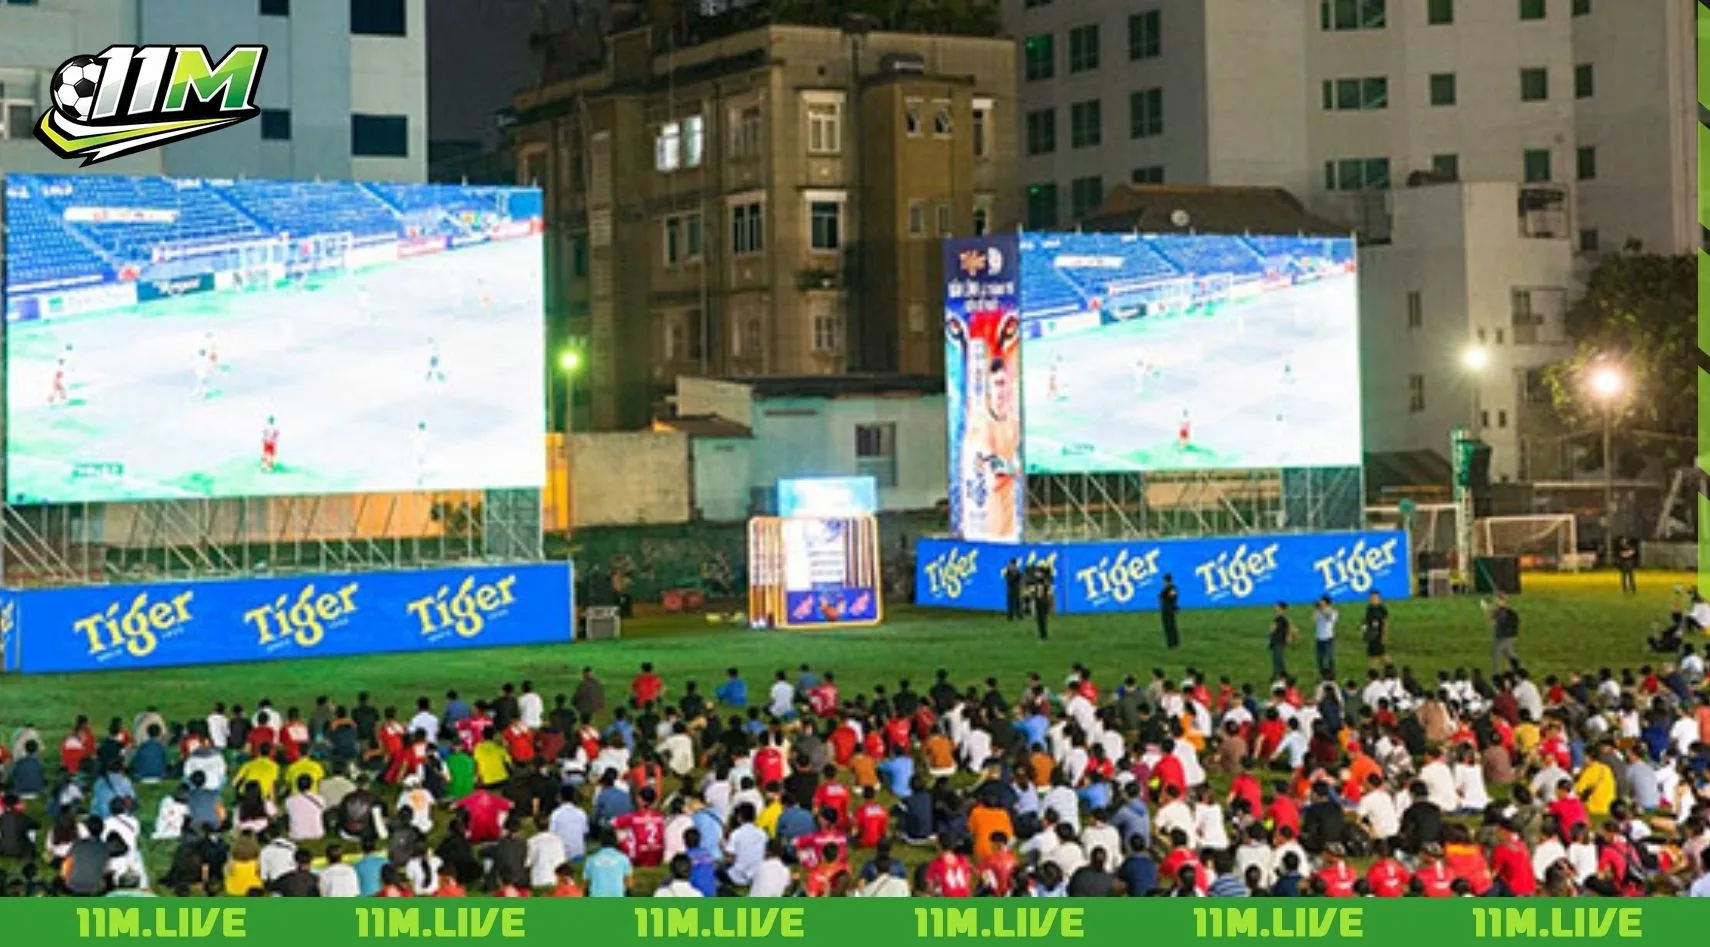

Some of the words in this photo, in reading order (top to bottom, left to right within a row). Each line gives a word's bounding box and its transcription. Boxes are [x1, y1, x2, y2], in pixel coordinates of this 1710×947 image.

[925, 547, 979, 598] Tiger
[1076, 548, 1160, 602] Tiger
[1195, 543, 1279, 597] Tiger
[1313, 538, 1398, 592] Tiger
[73, 590, 194, 657] Tiger
[244, 582, 359, 646] Tiger
[407, 574, 516, 637] Tiger
